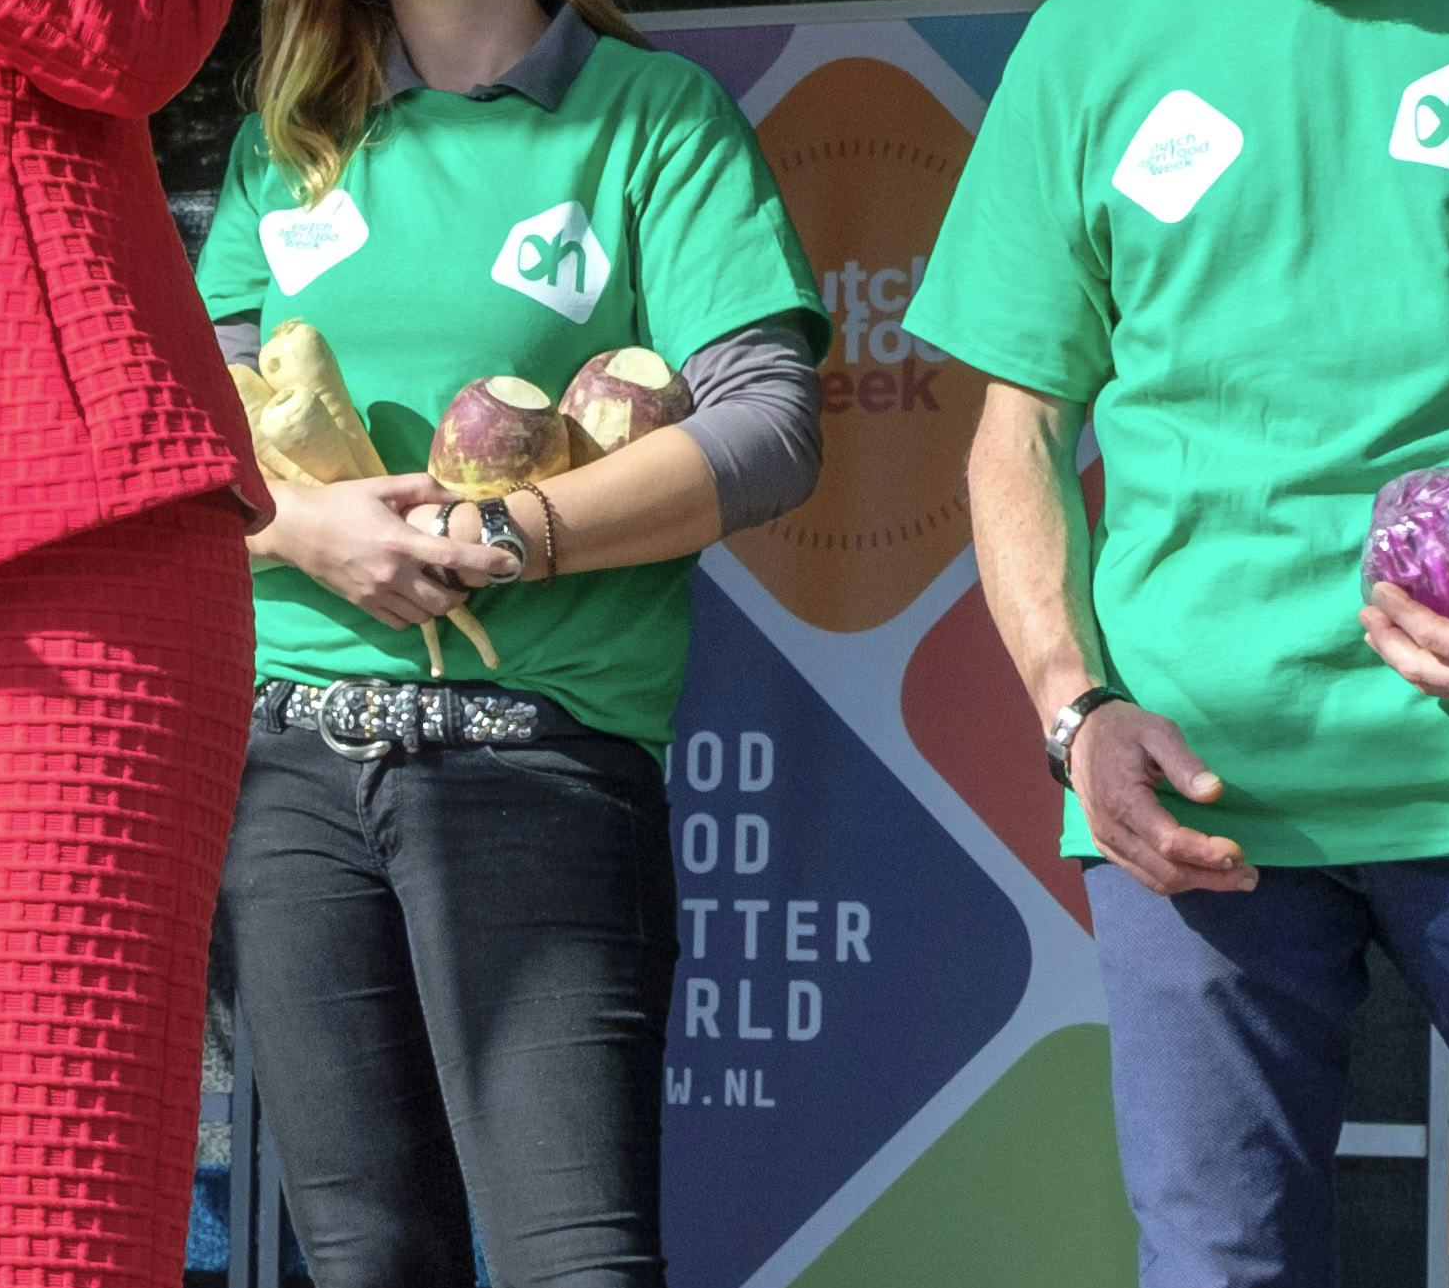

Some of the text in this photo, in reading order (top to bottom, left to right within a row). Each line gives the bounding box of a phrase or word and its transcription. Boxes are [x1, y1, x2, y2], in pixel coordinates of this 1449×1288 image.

[840, 303, 949, 365] fo
[820, 357, 943, 415] eek
[663, 729, 775, 794] OD
[681, 812, 770, 875] OD
[681, 897, 872, 964] TTER
[684, 976, 823, 1042] RLD
[665, 1066, 776, 1109] W.NL
